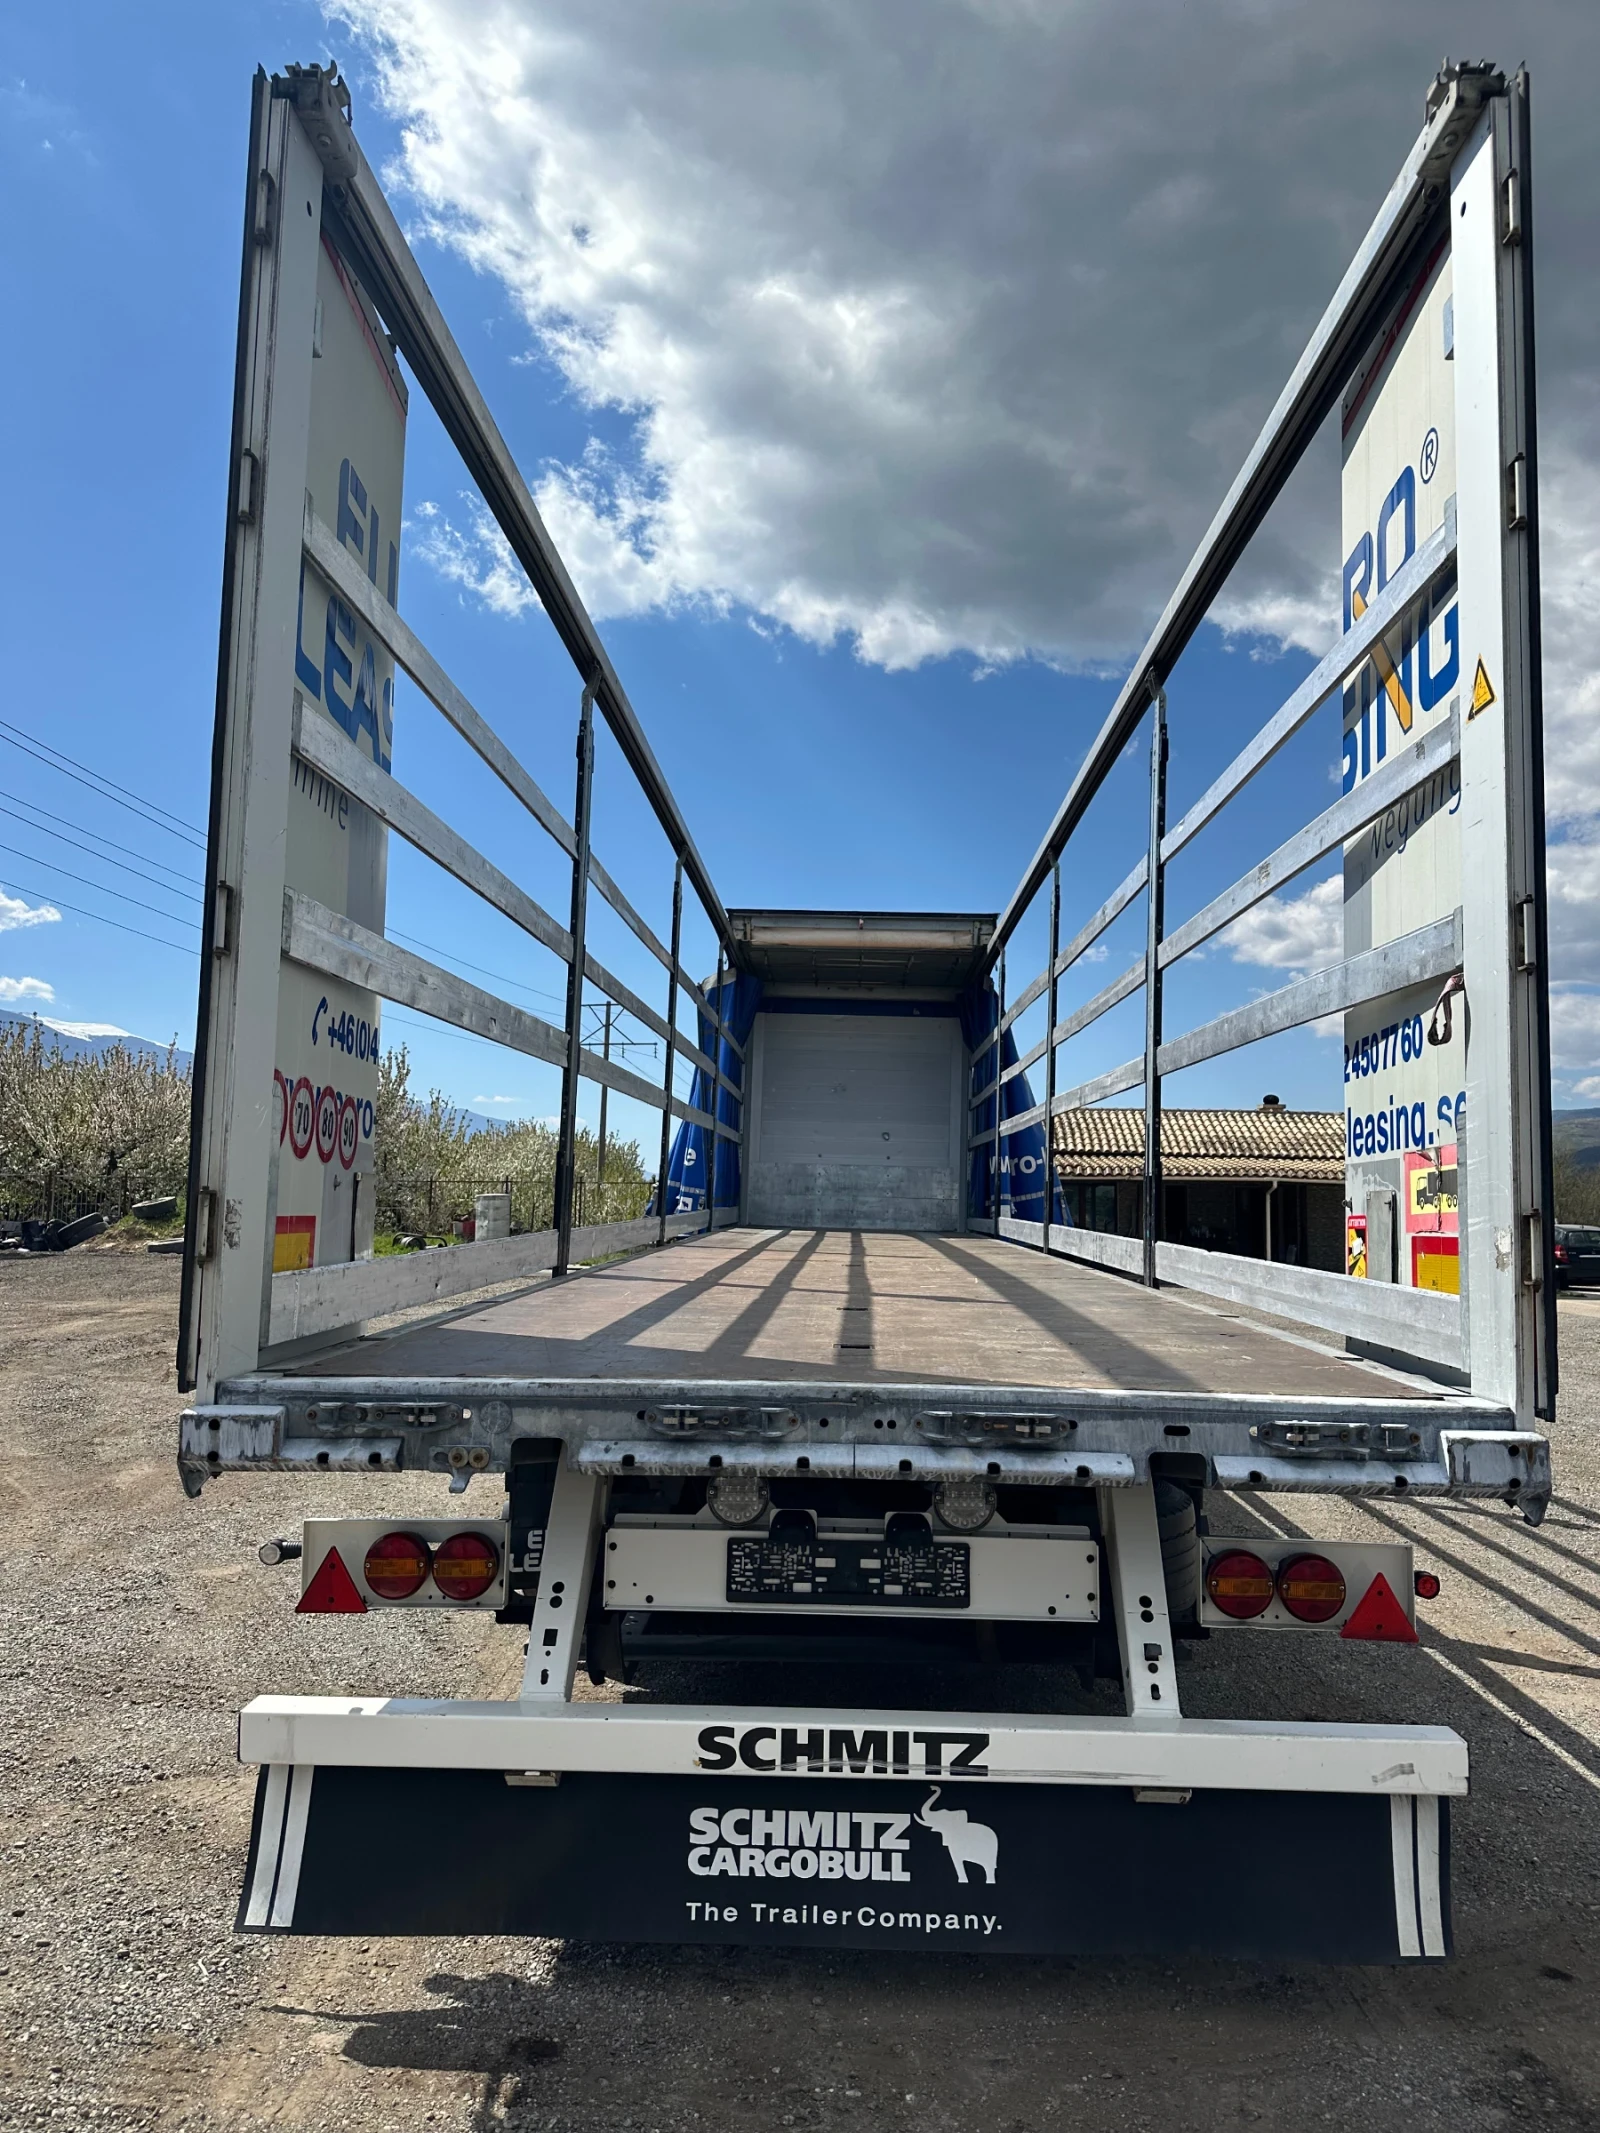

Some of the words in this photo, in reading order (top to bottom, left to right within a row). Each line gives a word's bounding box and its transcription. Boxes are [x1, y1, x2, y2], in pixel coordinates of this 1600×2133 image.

[296, 1102, 309, 1135] 70
[322, 1107, 333, 1140] 80
[343, 1117, 354, 1148] 90
[698, 1726, 990, 1777] SCHMITZ
[689, 1807, 911, 1850] SCHMITZ
[687, 1846, 911, 1882] CARGOBULL
[686, 1902, 738, 1923] The
